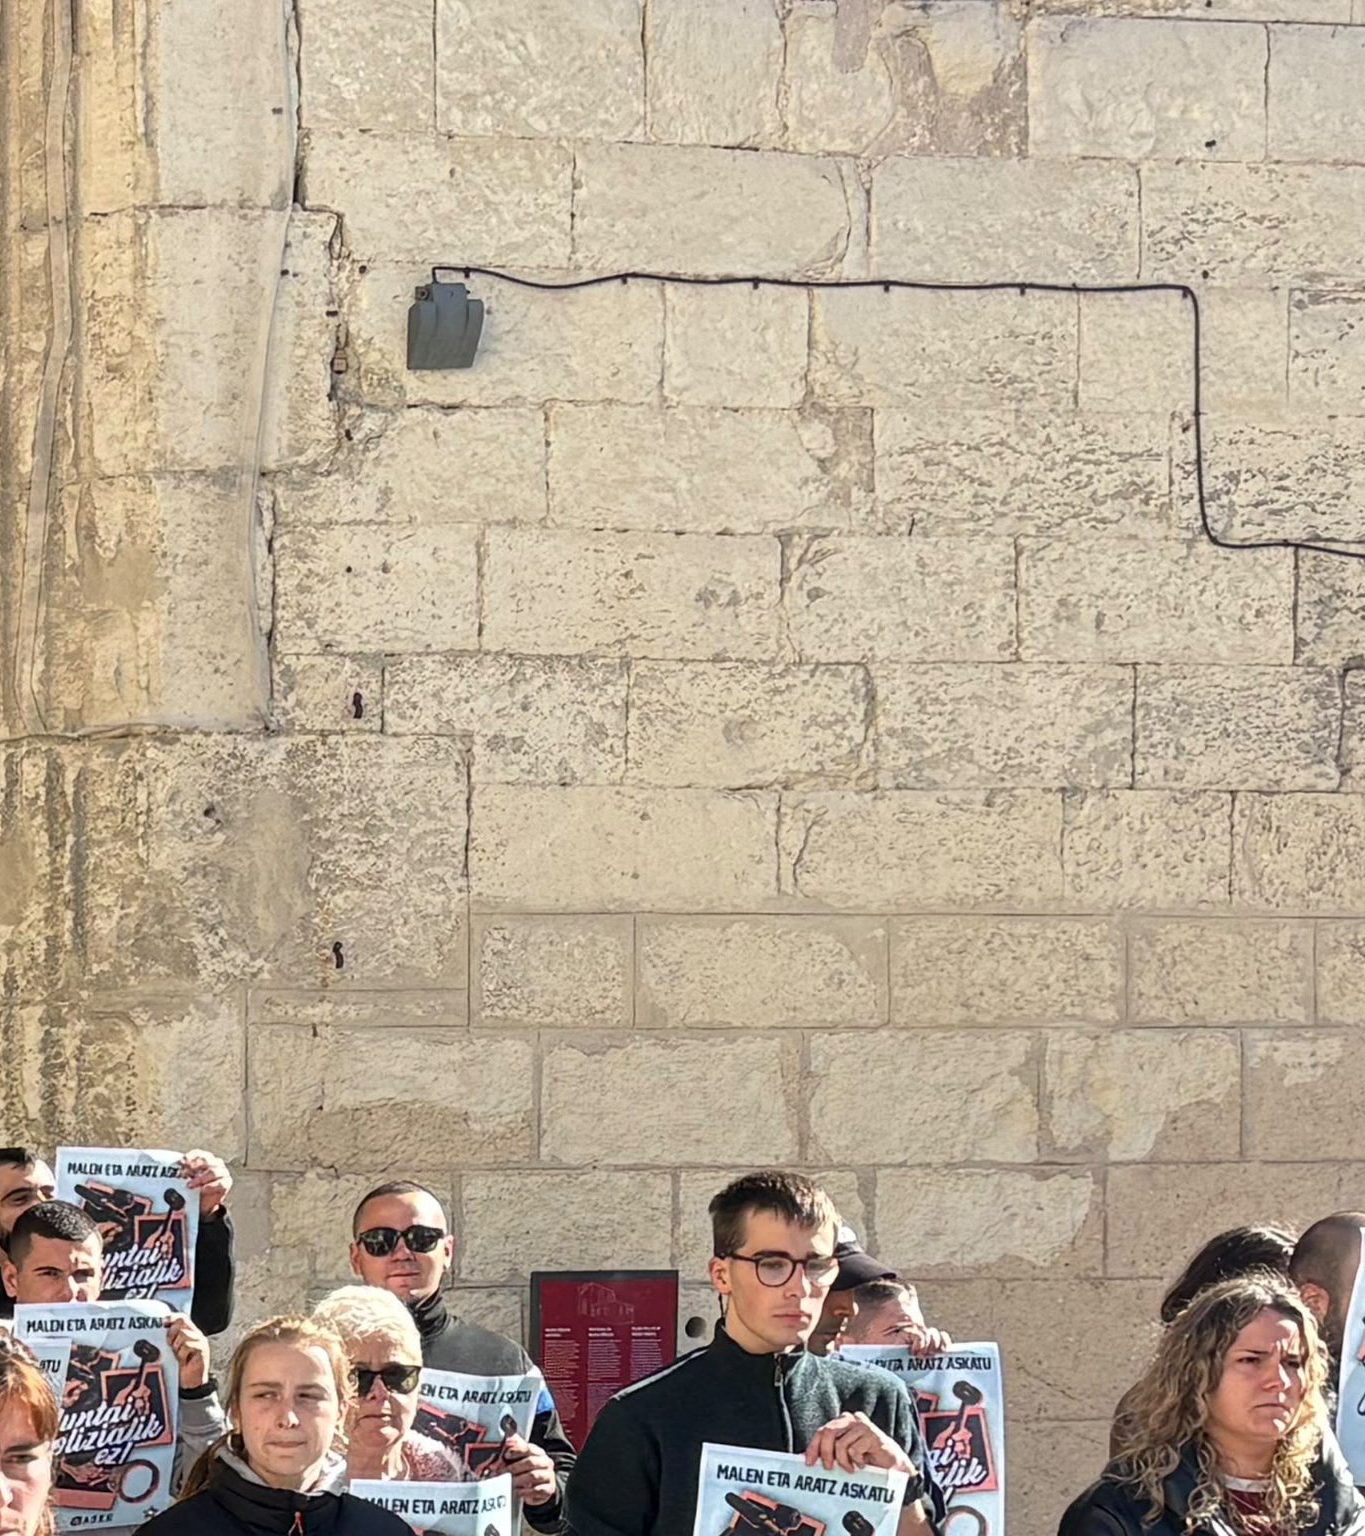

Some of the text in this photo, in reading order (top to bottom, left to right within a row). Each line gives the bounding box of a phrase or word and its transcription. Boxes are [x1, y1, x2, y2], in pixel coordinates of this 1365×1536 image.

[106, 1164, 123, 1176] ETA
[102, 1241, 161, 1268] untai
[103, 1258, 183, 1289] lizialik
[68, 1318, 86, 1331] ETA
[945, 1357, 989, 1370] ASKATU
[438, 1385, 458, 1400] ETA
[59, 1397, 134, 1432] untai
[53, 1413, 161, 1456] olizialik
[95, 1441, 132, 1464] ez!
[717, 1465, 894, 1503] MALEN ETA ARATZ ASKATU
[412, 1499, 435, 1514] ETA
[439, 1500, 479, 1515] ARATZ
